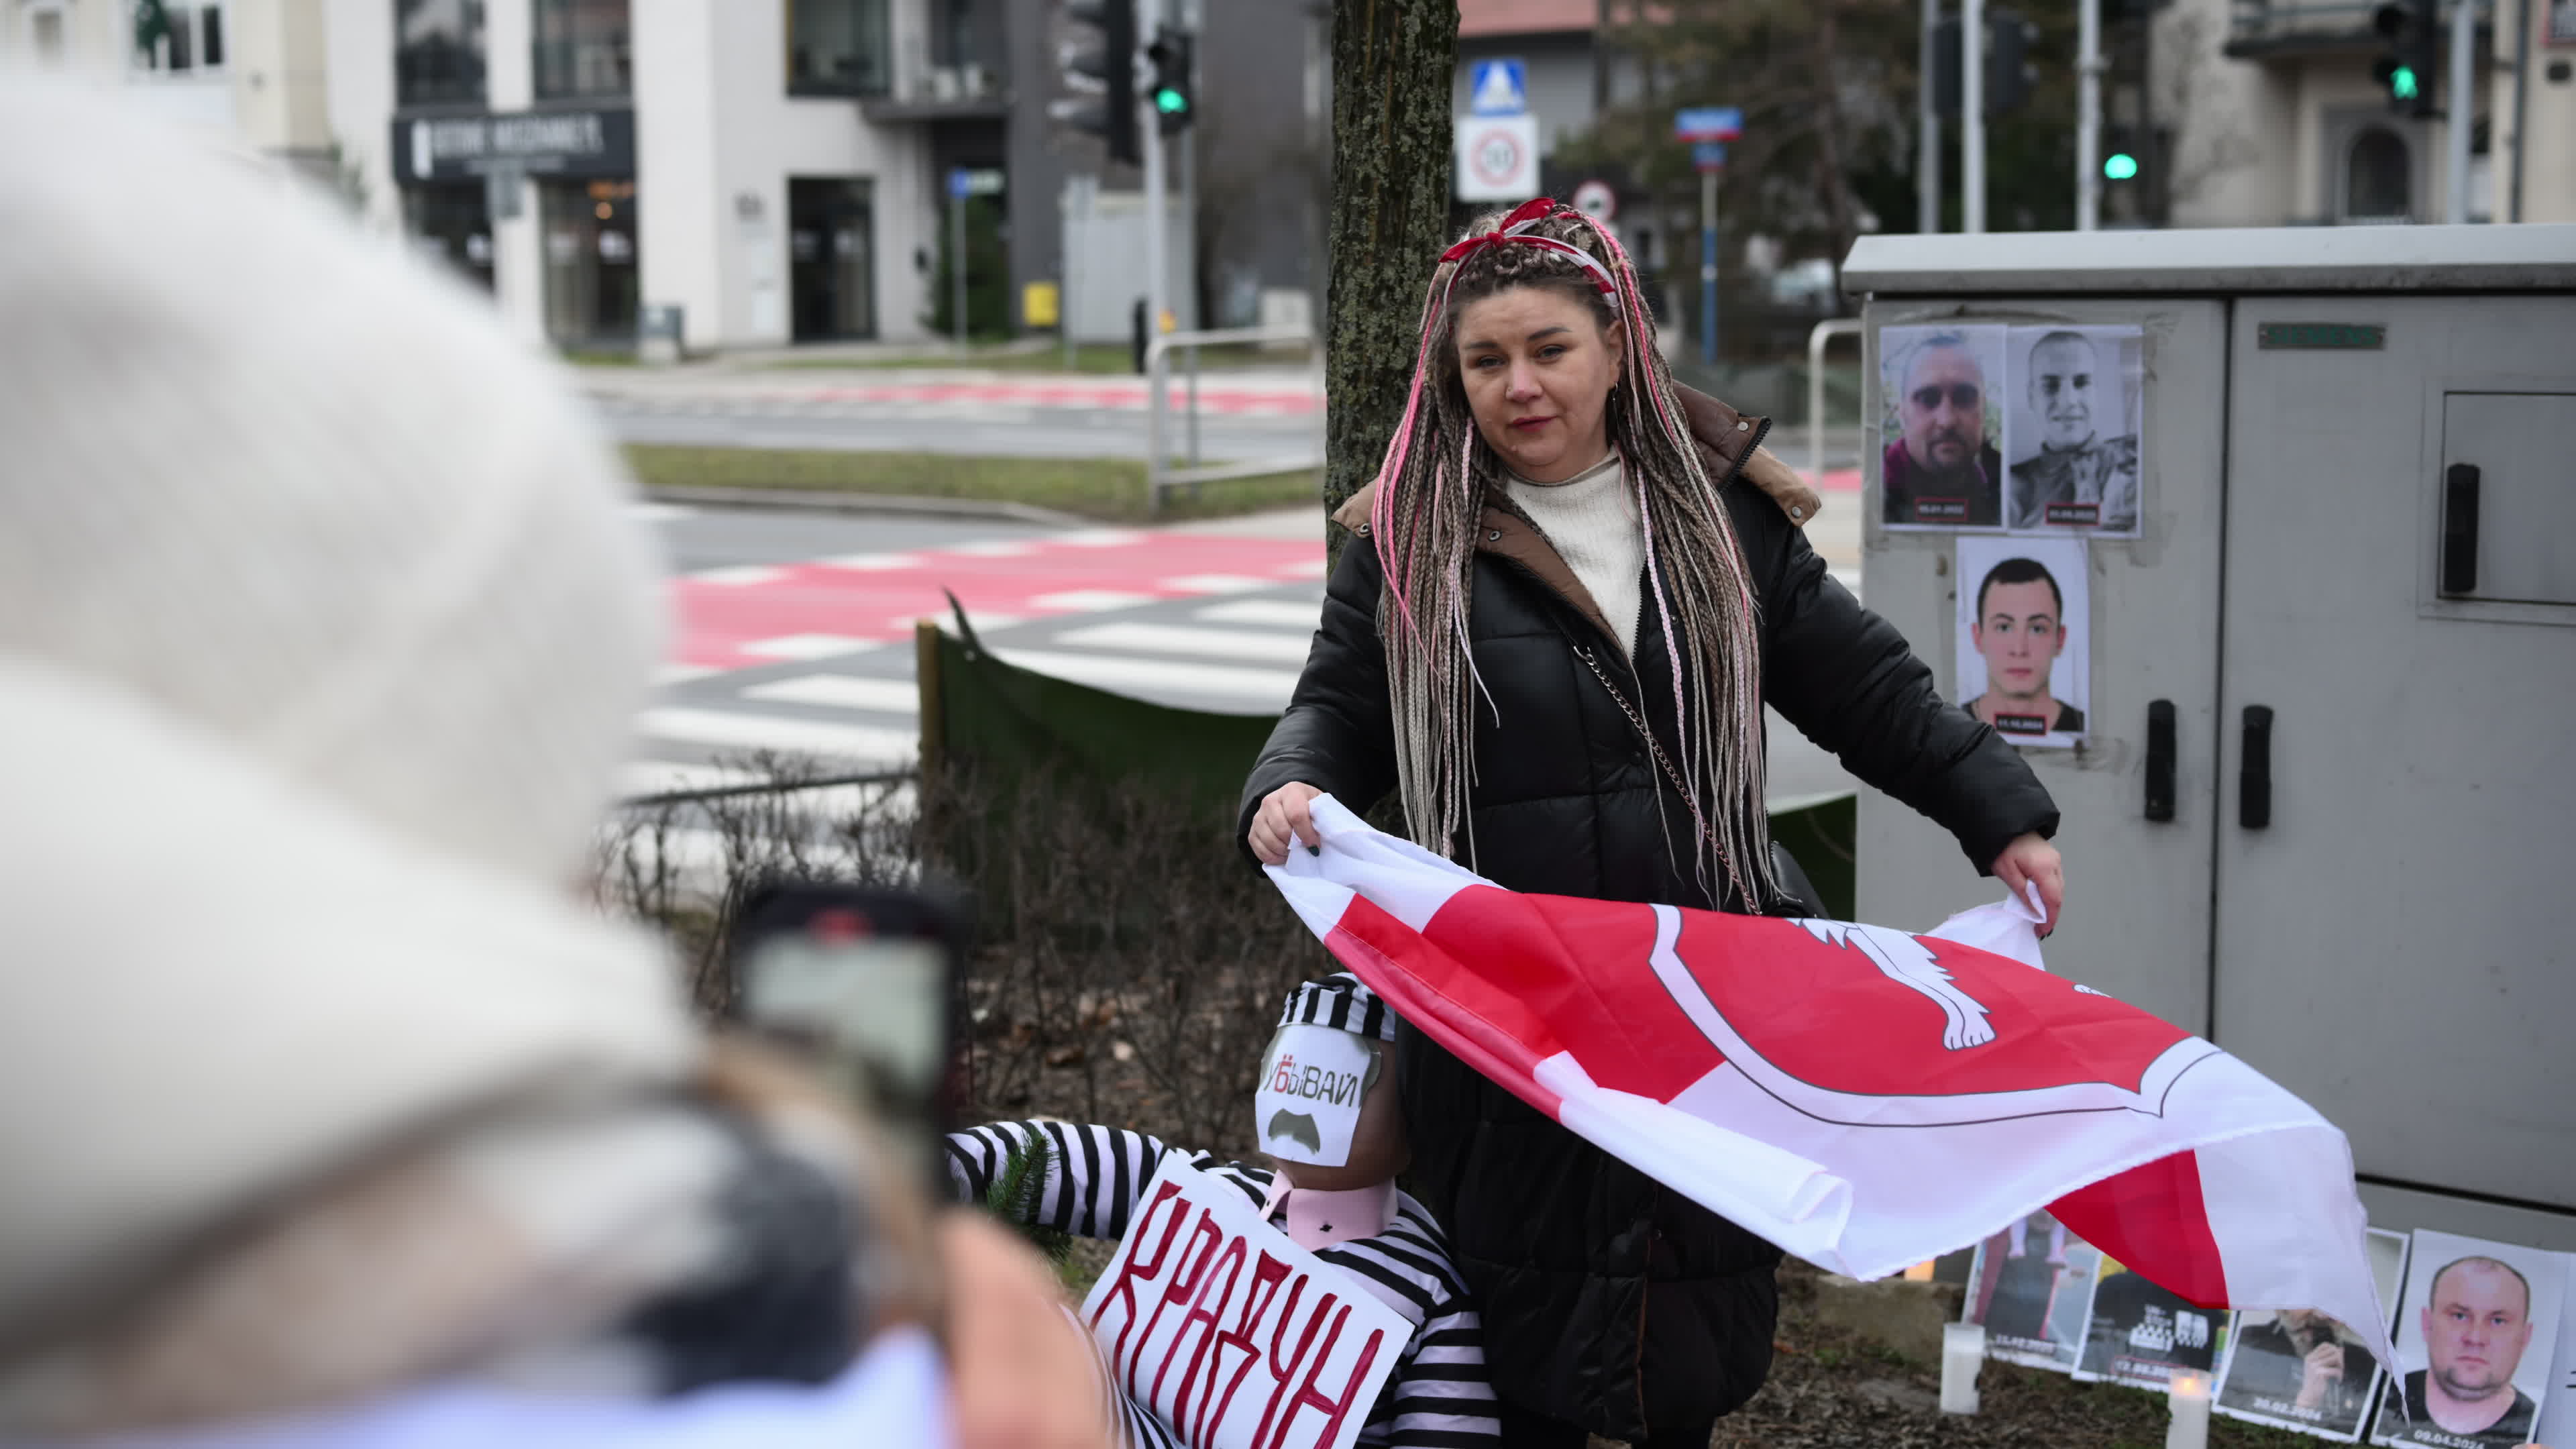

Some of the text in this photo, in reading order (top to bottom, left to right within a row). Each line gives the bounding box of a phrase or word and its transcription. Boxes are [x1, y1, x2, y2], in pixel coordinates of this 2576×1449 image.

[2267, 327, 2377, 345] SIEMENS
[1090, 1179, 1384, 1449] КРАДУН
[2414, 1429, 2486, 1449] 09.04.2024
